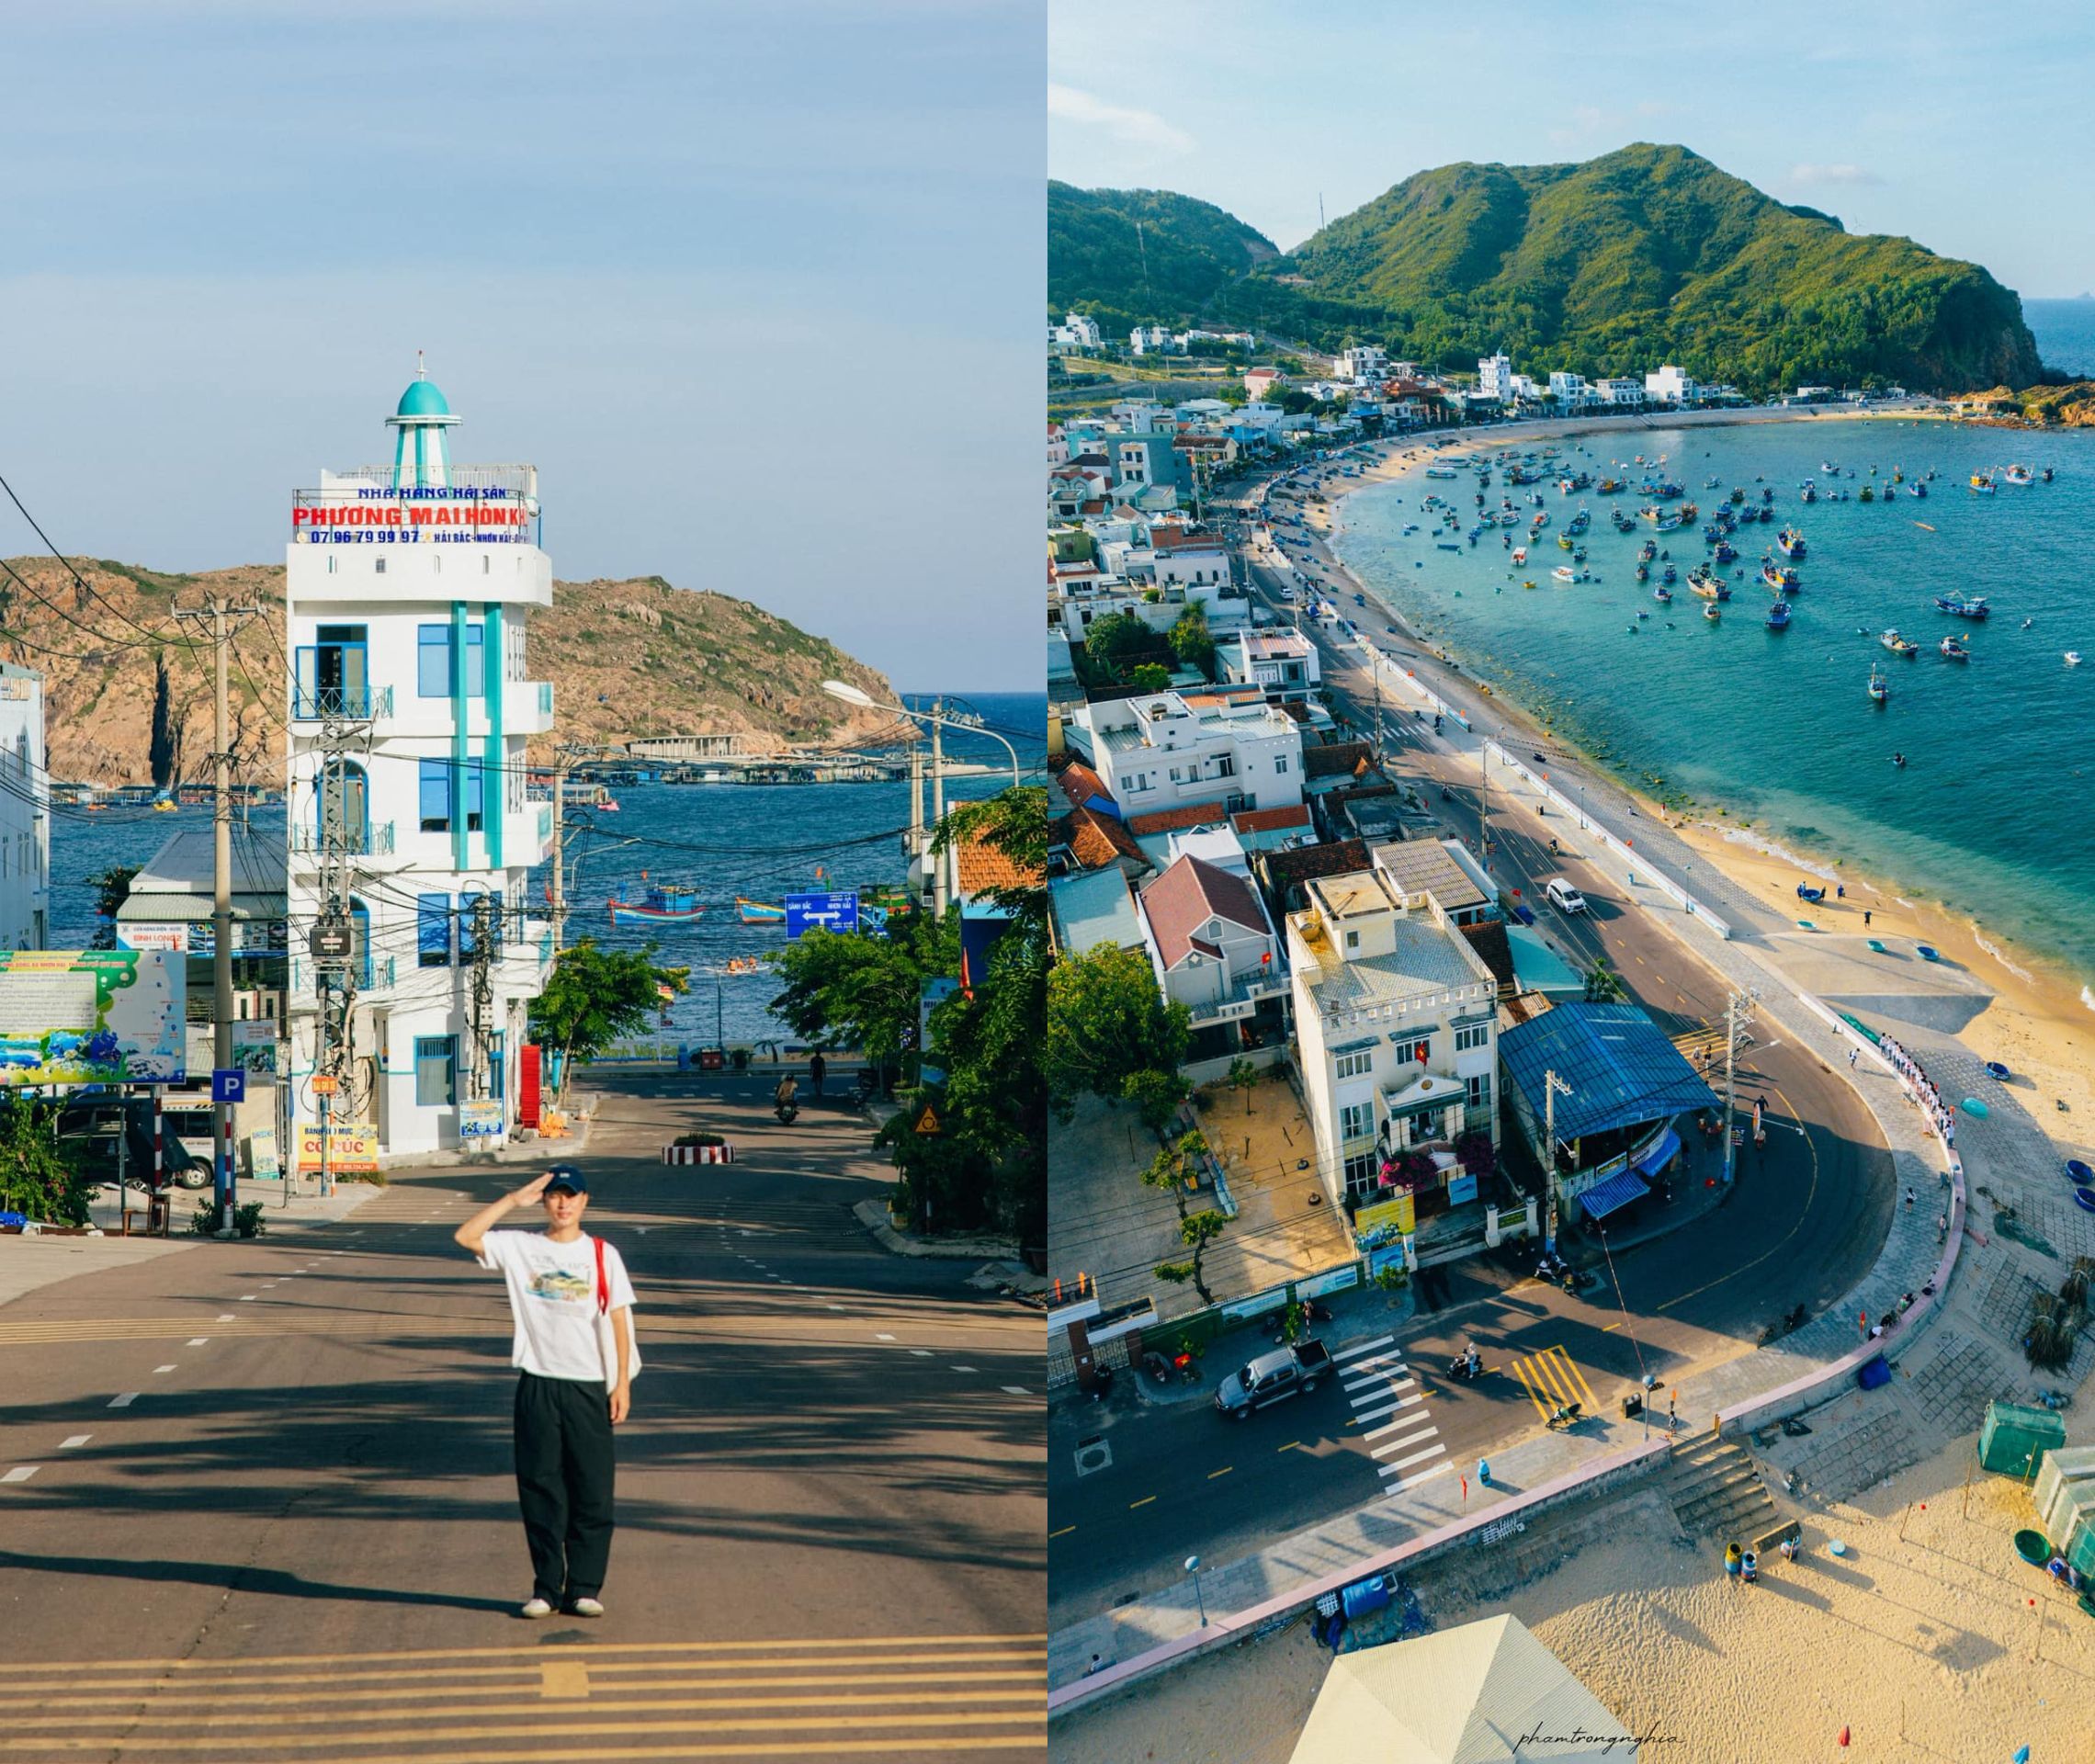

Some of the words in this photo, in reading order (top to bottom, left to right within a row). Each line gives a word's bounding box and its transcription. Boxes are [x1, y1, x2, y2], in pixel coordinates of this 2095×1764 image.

[293, 506, 402, 526] PHƯƠNG
[410, 506, 459, 526] MAI
[465, 502, 506, 526] HÒN
[311, 531, 329, 544] 07
[334, 531, 351, 544] 96
[356, 531, 374, 544] 79
[378, 531, 395, 544] 99
[402, 530, 419, 544] 97
[224, 1078, 240, 1095] P
